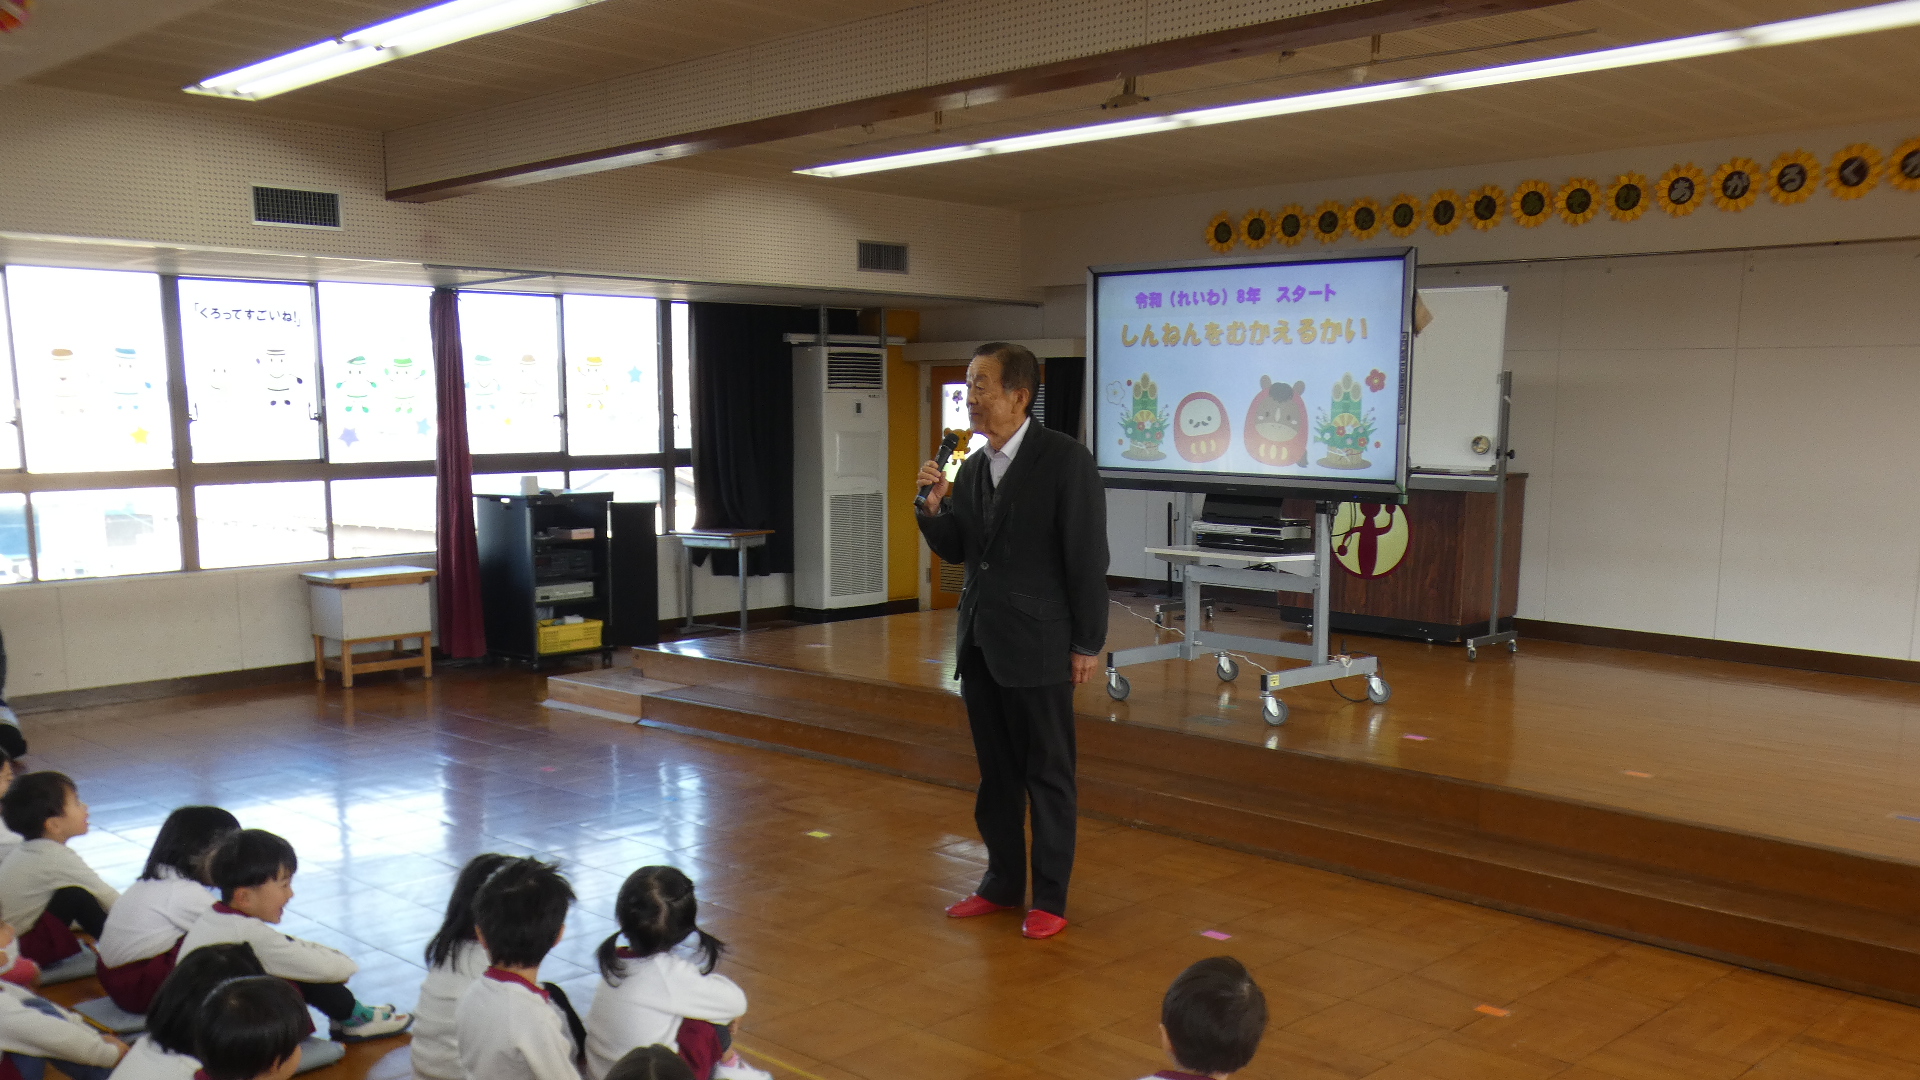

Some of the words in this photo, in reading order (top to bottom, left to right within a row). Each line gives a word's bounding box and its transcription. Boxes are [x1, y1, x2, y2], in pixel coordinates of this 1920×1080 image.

[1276, 284, 1337, 303] スタート
[1121, 318, 1368, 347] しんねんをむかえるかい
